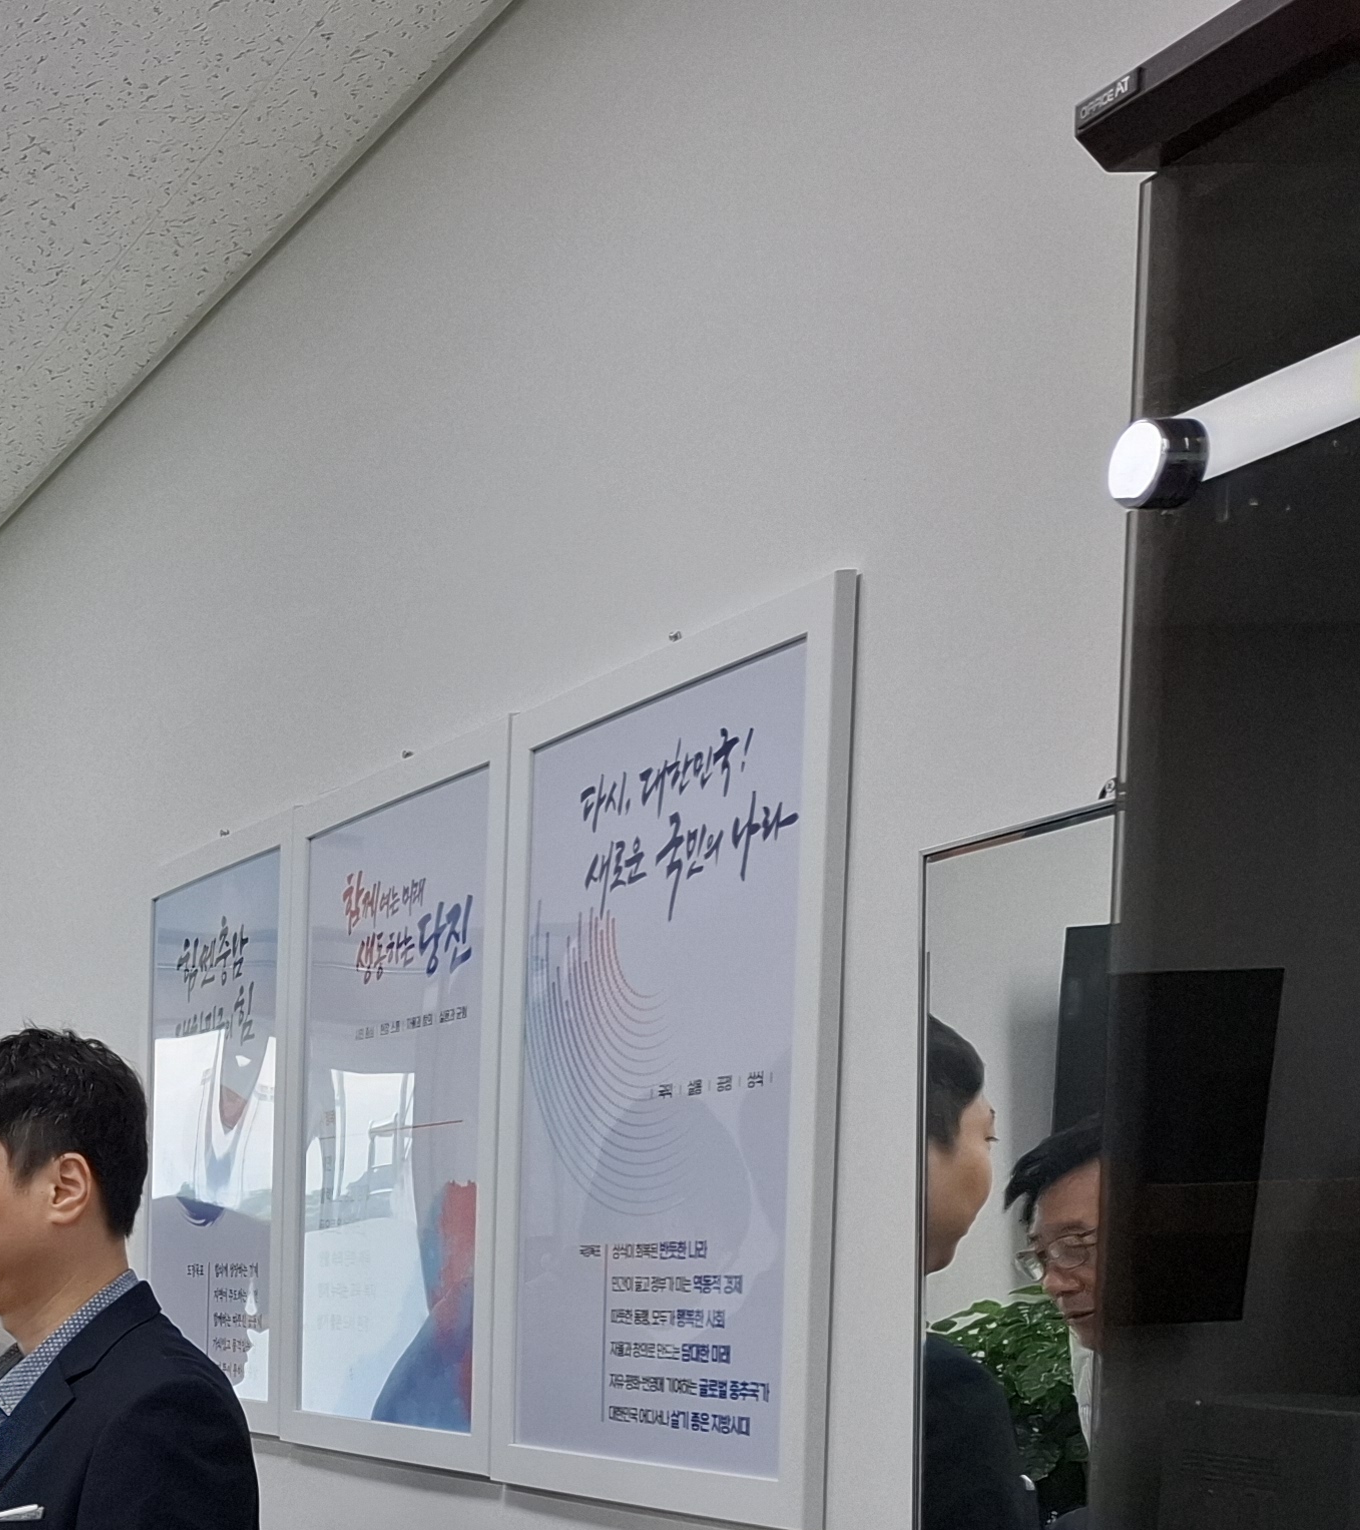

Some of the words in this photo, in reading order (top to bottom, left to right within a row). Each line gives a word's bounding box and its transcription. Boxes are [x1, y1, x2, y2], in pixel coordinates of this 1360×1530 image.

[1115, 75, 1130, 98] AT
[639, 727, 754, 818] 대한민국!
[584, 836, 647, 920] 새로운
[656, 811, 724, 922] 국민의
[732, 790, 799, 882] 나라
[342, 870, 381, 936] 함께
[402, 877, 426, 916] 미래
[356, 926, 415, 985] 생동하는
[417, 894, 473, 978] 당진
[234, 981, 255, 1046] 힘
[747, 1070, 764, 1088] 상식
[688, 1240, 708, 1259] 나라
[723, 1274, 743, 1294] 경제
[676, 1308, 704, 1328] 행복한
[706, 1308, 725, 1329] 사회
[681, 1343, 709, 1362] 담대한
[711, 1344, 731, 1364] 미래
[699, 1378, 728, 1399] 글로벌
[729, 1380, 770, 1403] 중추국가
[608, 1405, 638, 1422] 대한민국
[639, 1408, 670, 1426] 어디서나
[670, 1409, 689, 1430] 살기
[691, 1411, 710, 1432] 좋은
[711, 1413, 751, 1437] 지방시대
